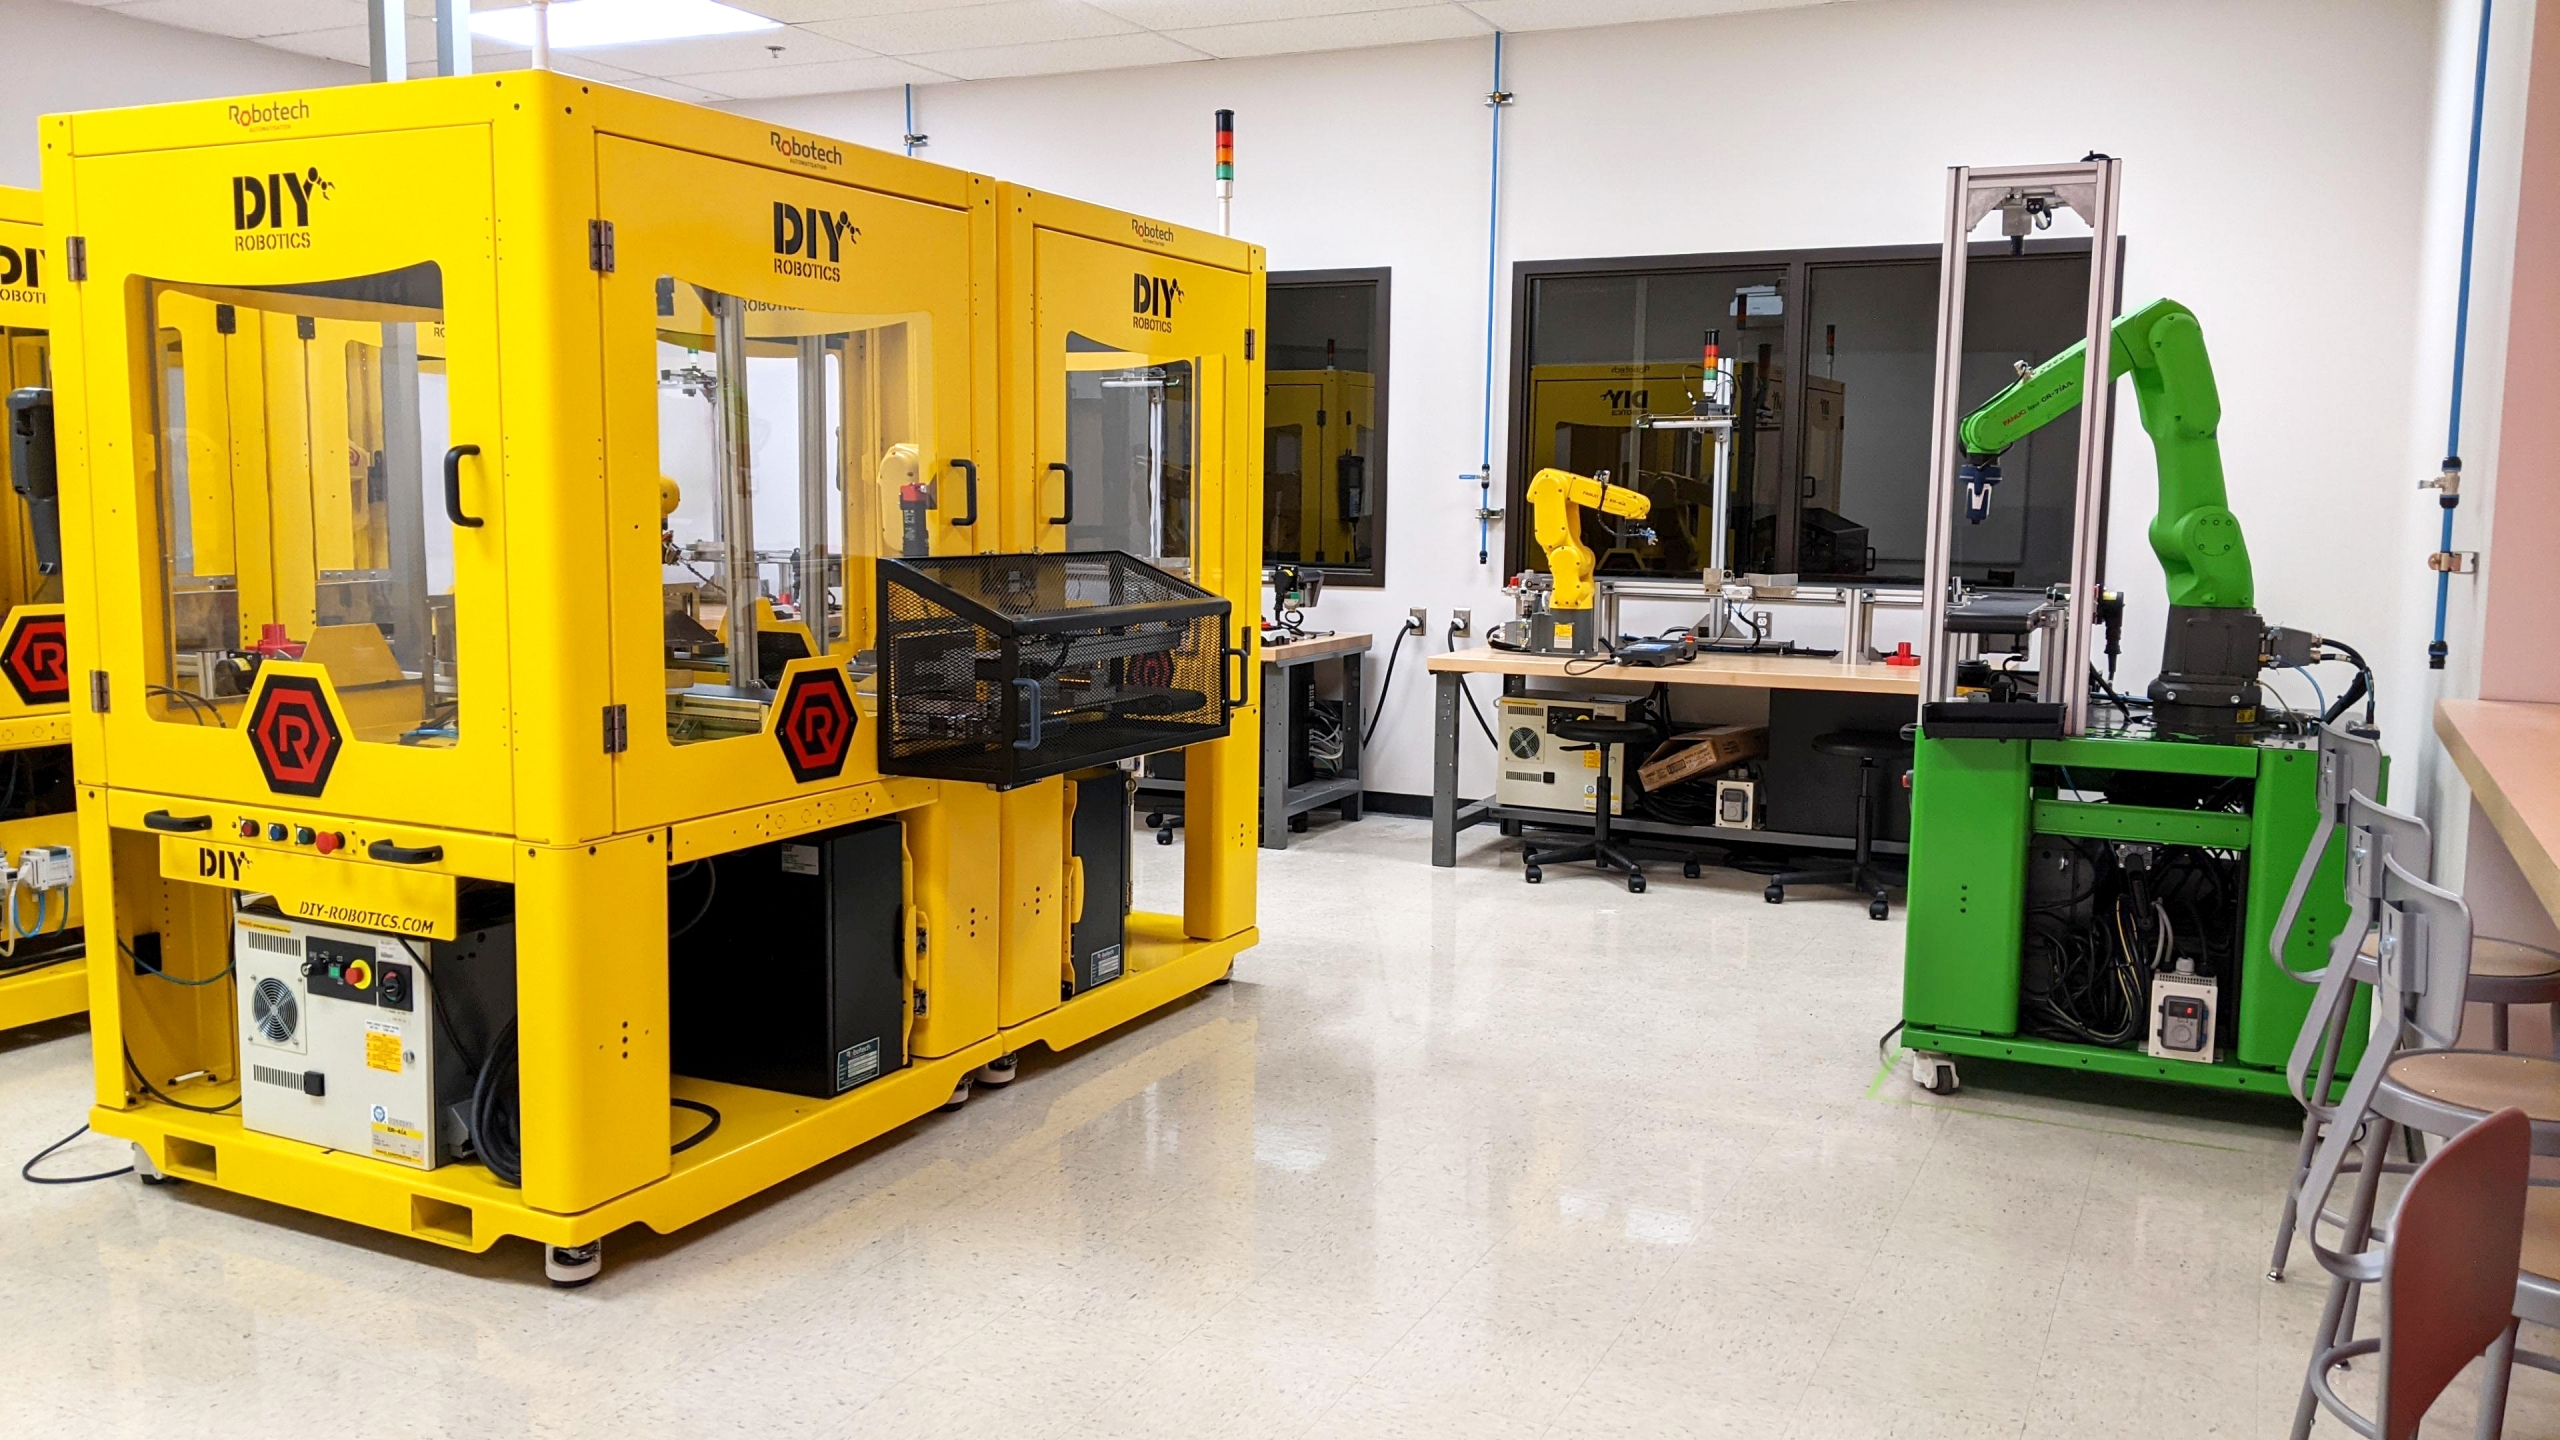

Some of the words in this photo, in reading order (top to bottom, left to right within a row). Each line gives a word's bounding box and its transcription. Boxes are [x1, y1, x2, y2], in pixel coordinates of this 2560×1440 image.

[228, 99, 310, 127] Robotech
[770, 131, 842, 166] Robotech
[232, 172, 314, 231] DIY
[234, 231, 312, 252] ROBOTICS
[773, 201, 844, 264] DIY
[1131, 218, 1174, 243] Robotech
[0, 244, 46, 288] DI
[773, 257, 841, 283] ROBOTICS
[1133, 272, 1175, 319] DIY
[1132, 315, 1173, 334] ROBOTICS
[199, 847, 243, 882] DIY
[299, 901, 435, 935] DIY-ROBOTICS.COM
